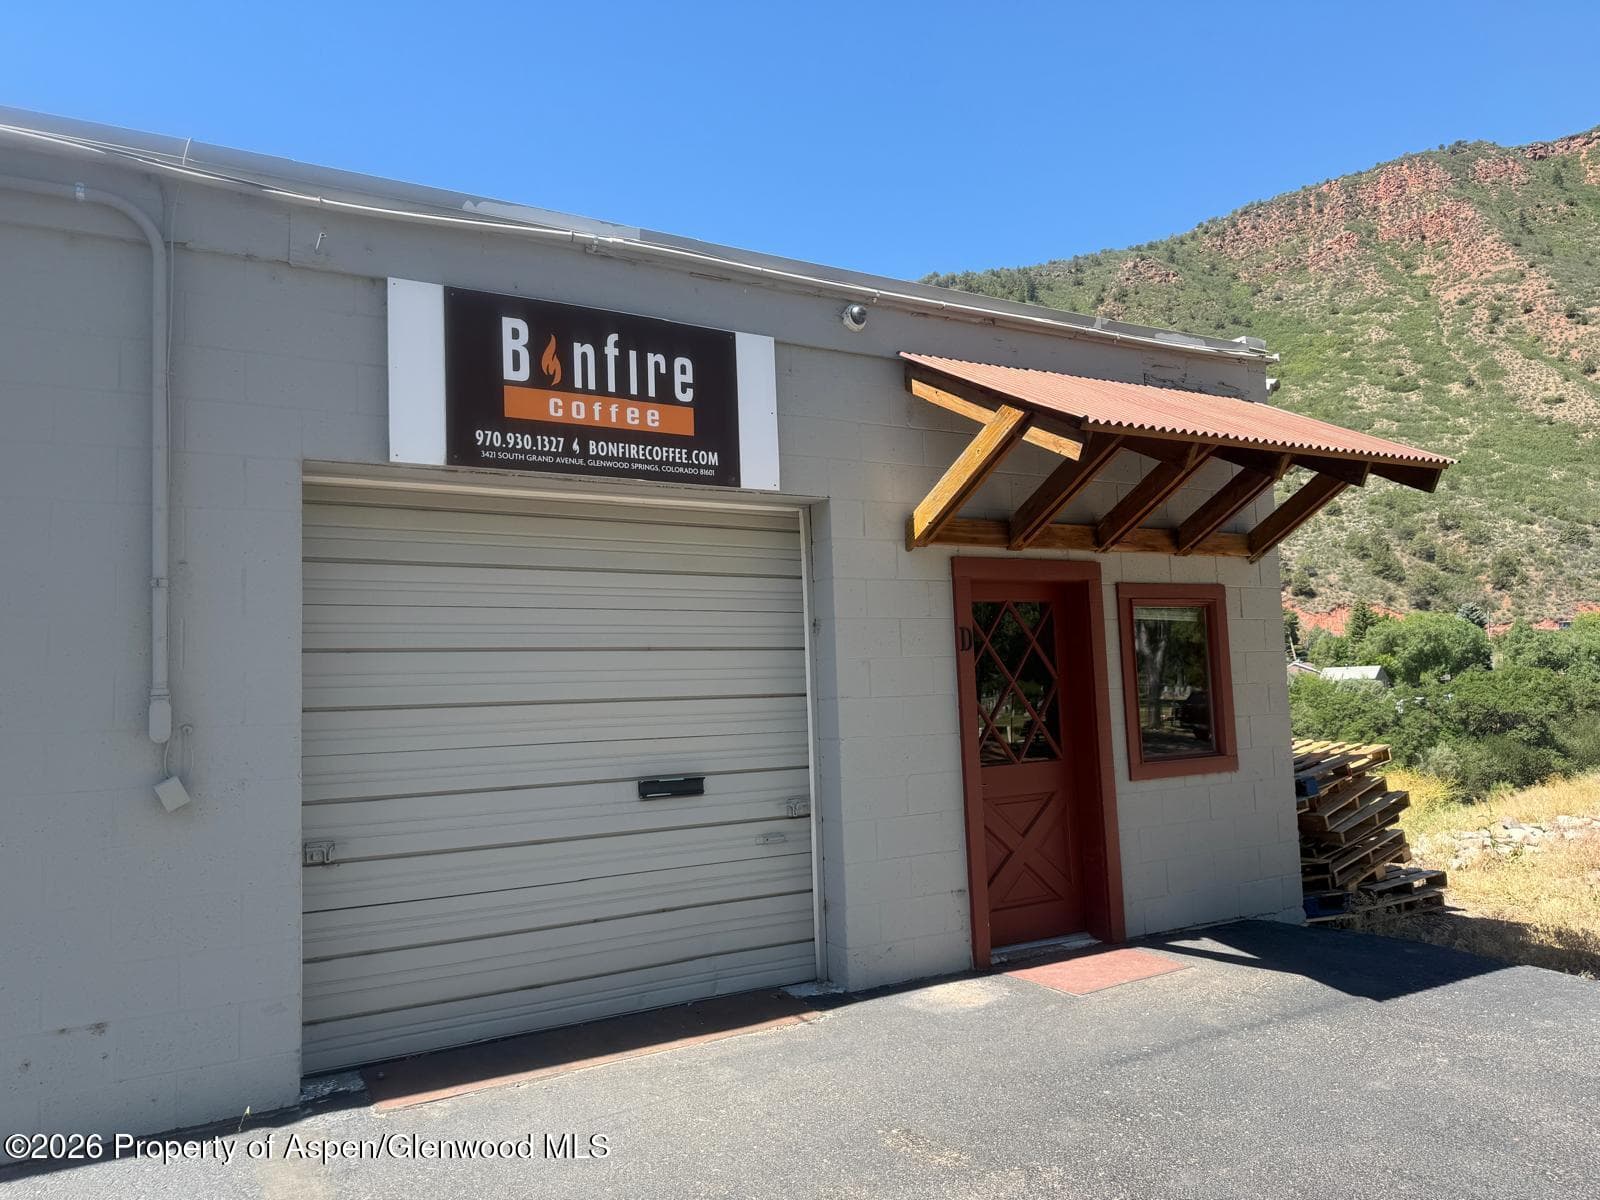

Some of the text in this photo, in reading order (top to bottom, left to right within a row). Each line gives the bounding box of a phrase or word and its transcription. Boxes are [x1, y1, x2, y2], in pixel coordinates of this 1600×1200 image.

[548, 398, 660, 426] coffee
[475, 429, 719, 467] 970.930.1327 BONFIRECOFFEE.COM
[480, 450, 496, 459] 3421
[497, 452, 525, 461] SOUTH
[526, 454, 555, 464] GRAND
[587, 459, 630, 470] GLENWOOD
[630, 462, 661, 473] SPRINGS,
[661, 465, 699, 476] COLORADO
[699, 469, 715, 477] 81601
[959, 626, 972, 651] D
